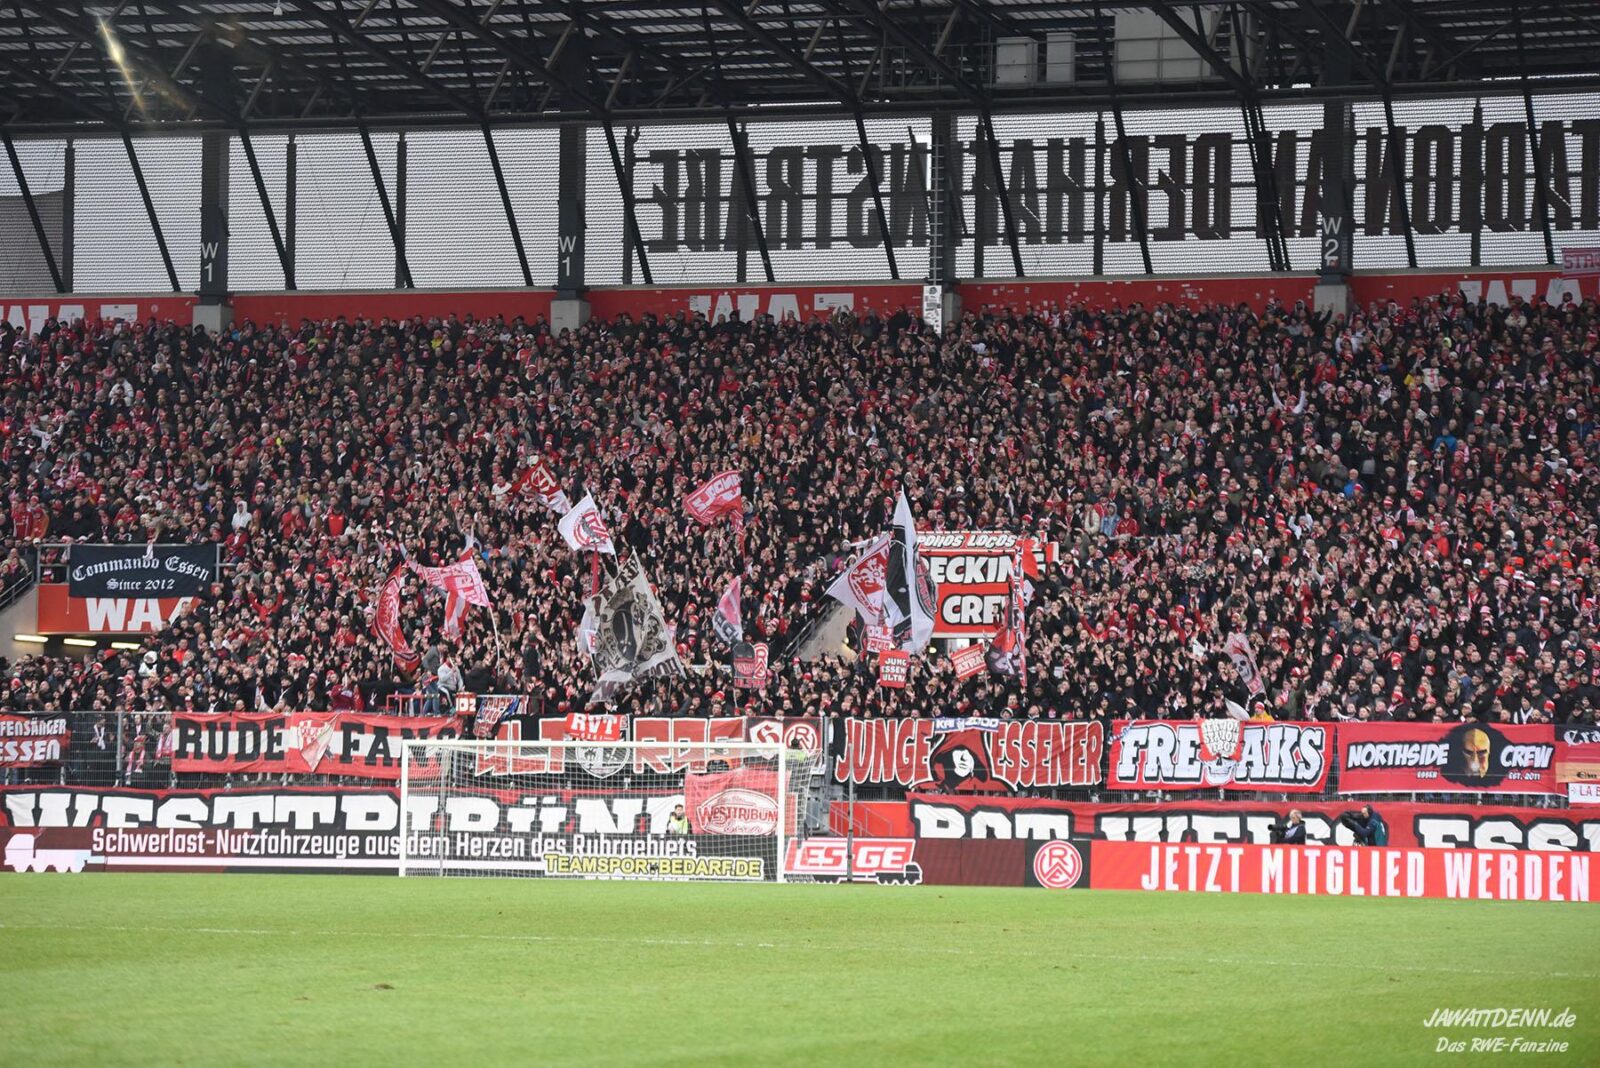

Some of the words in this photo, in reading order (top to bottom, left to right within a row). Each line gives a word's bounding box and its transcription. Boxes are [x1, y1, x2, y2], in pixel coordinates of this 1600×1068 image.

[1322, 216, 1342, 235] W
[201, 241, 219, 260] W
[558, 235, 577, 253] W
[1324, 238, 1339, 260] 2
[203, 262, 214, 282] 1
[561, 256, 571, 277] 1
[164, 555, 210, 582] Essen
[106, 578, 142, 591] Since
[144, 578, 176, 591] 2012
[943, 594, 1009, 626] CRE
[571, 713, 618, 735] RVT
[0, 738, 61, 762] SSEN
[175, 717, 286, 762] RUDE
[340, 720, 462, 768] FAN
[834, 716, 934, 786] JUNGE
[996, 719, 1105, 787] ESSENER
[1347, 742, 1450, 769] NORTHSIDE
[1499, 744, 1554, 769] CREW
[92, 828, 359, 860] Schwerlast-Nutzfahrzeuge
[365, 832, 400, 857] aus
[407, 830, 450, 857] dem
[455, 832, 525, 858] Herzen
[531, 832, 566, 858] des
[573, 833, 698, 859] Ruhrgebiets
[1418, 818, 1600, 852] ESS
[1141, 845, 1244, 893] JETZT
[1261, 847, 1425, 898] MITGLIED
[1443, 852, 1590, 902] WERDEN
